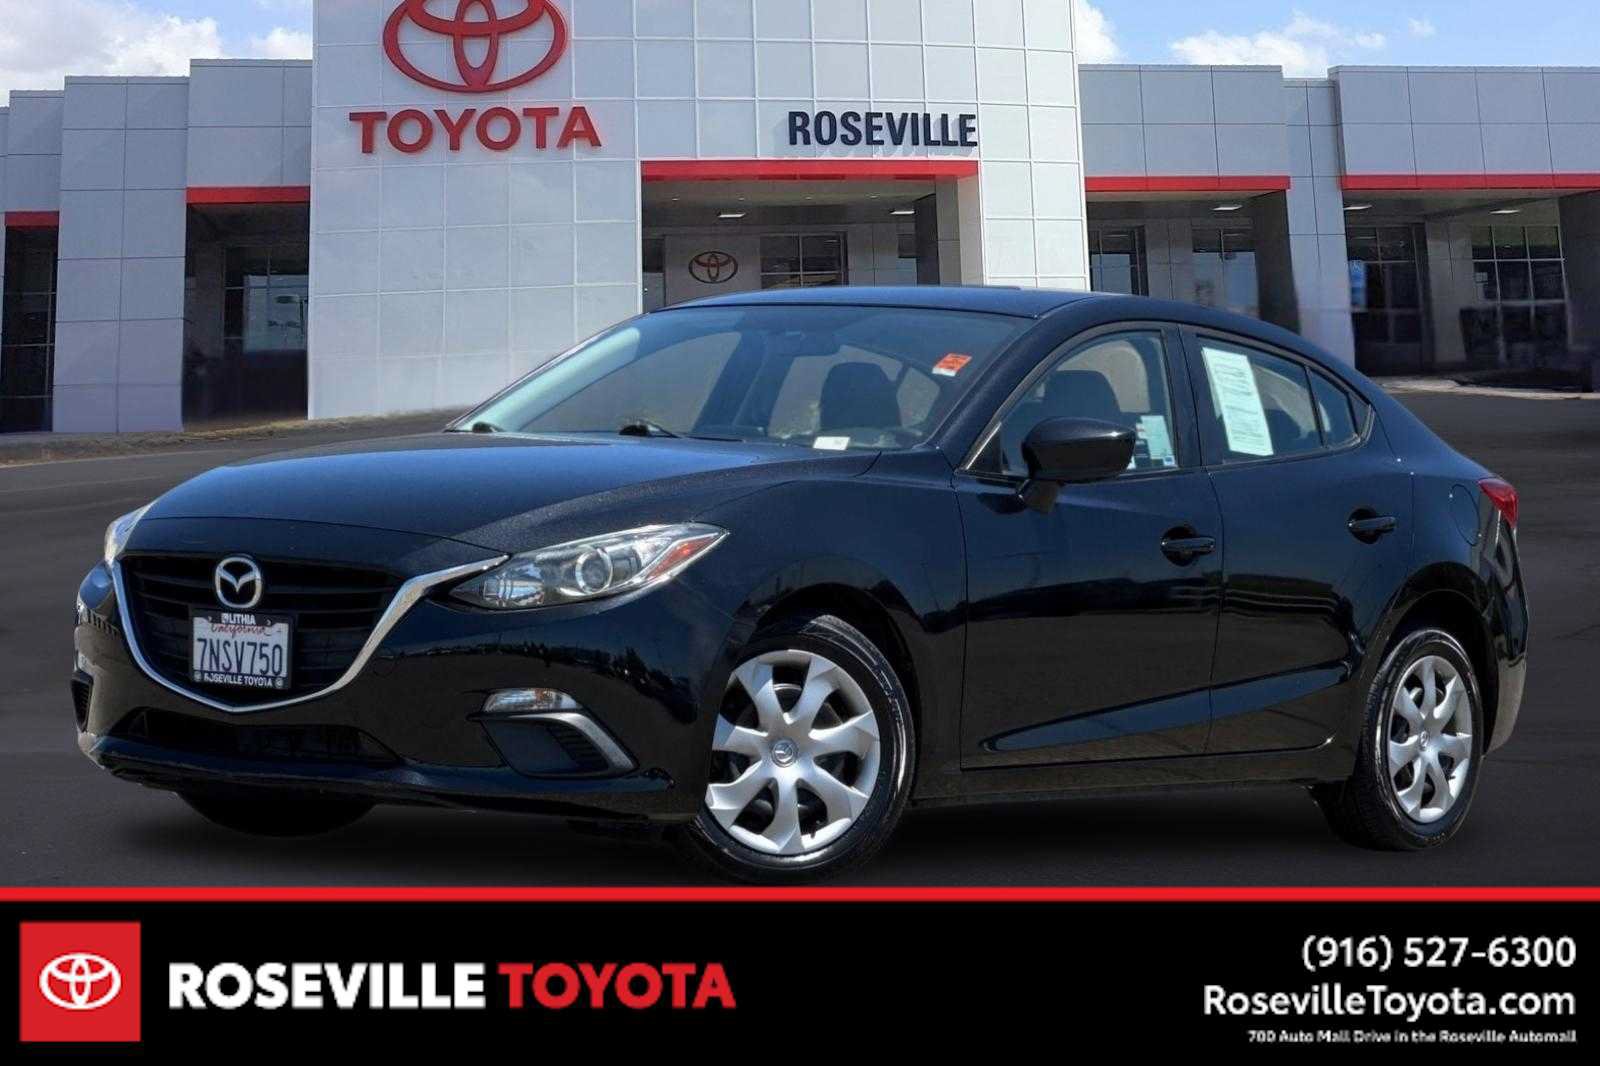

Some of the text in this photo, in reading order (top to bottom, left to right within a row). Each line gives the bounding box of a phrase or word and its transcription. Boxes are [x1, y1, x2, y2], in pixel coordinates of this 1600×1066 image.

[349, 106, 602, 154] TOYOTA
[788, 110, 978, 148] ROSEVILLE
[229, 613, 257, 625] LITHIA
[196, 638, 283, 676] 7NSV750
